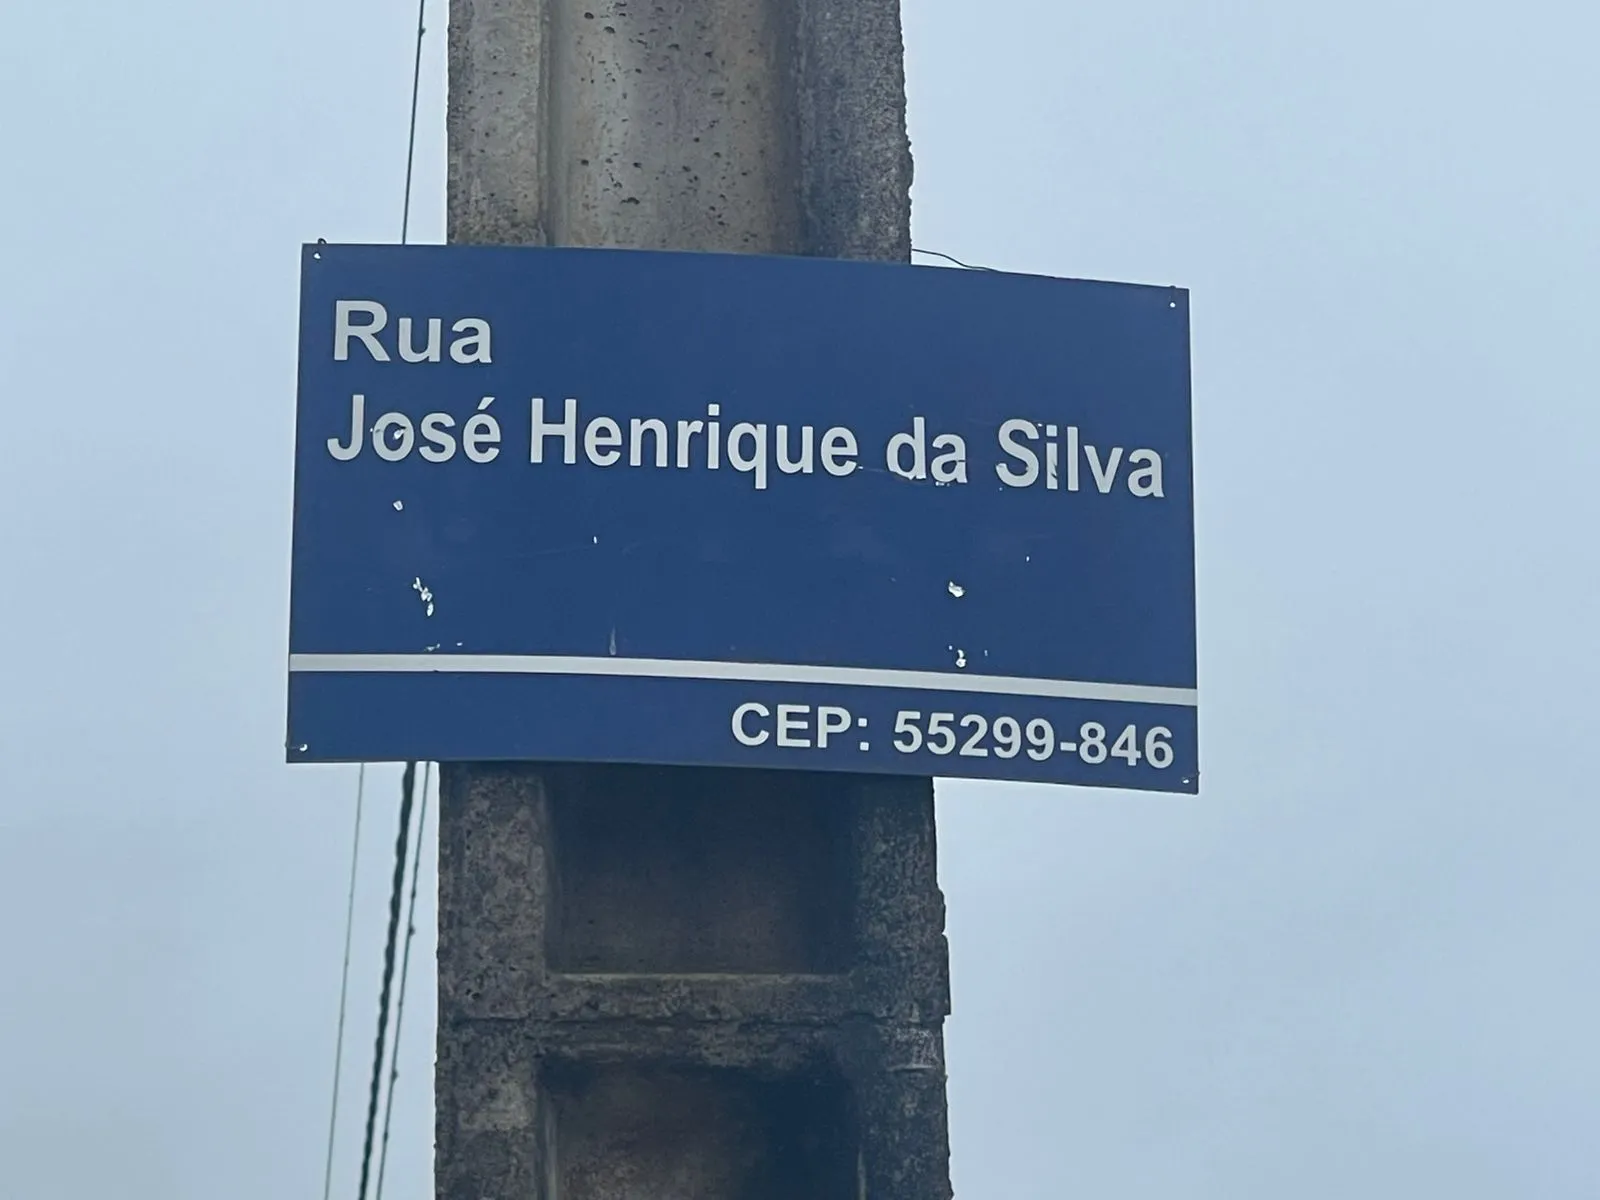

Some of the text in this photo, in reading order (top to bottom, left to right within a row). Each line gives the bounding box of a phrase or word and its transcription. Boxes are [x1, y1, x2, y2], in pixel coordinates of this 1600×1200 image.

[334, 300, 492, 364] Rua
[327, 394, 1164, 498] José Henrique da Silva
[731, 702, 1174, 769] CEP: 55299-846
